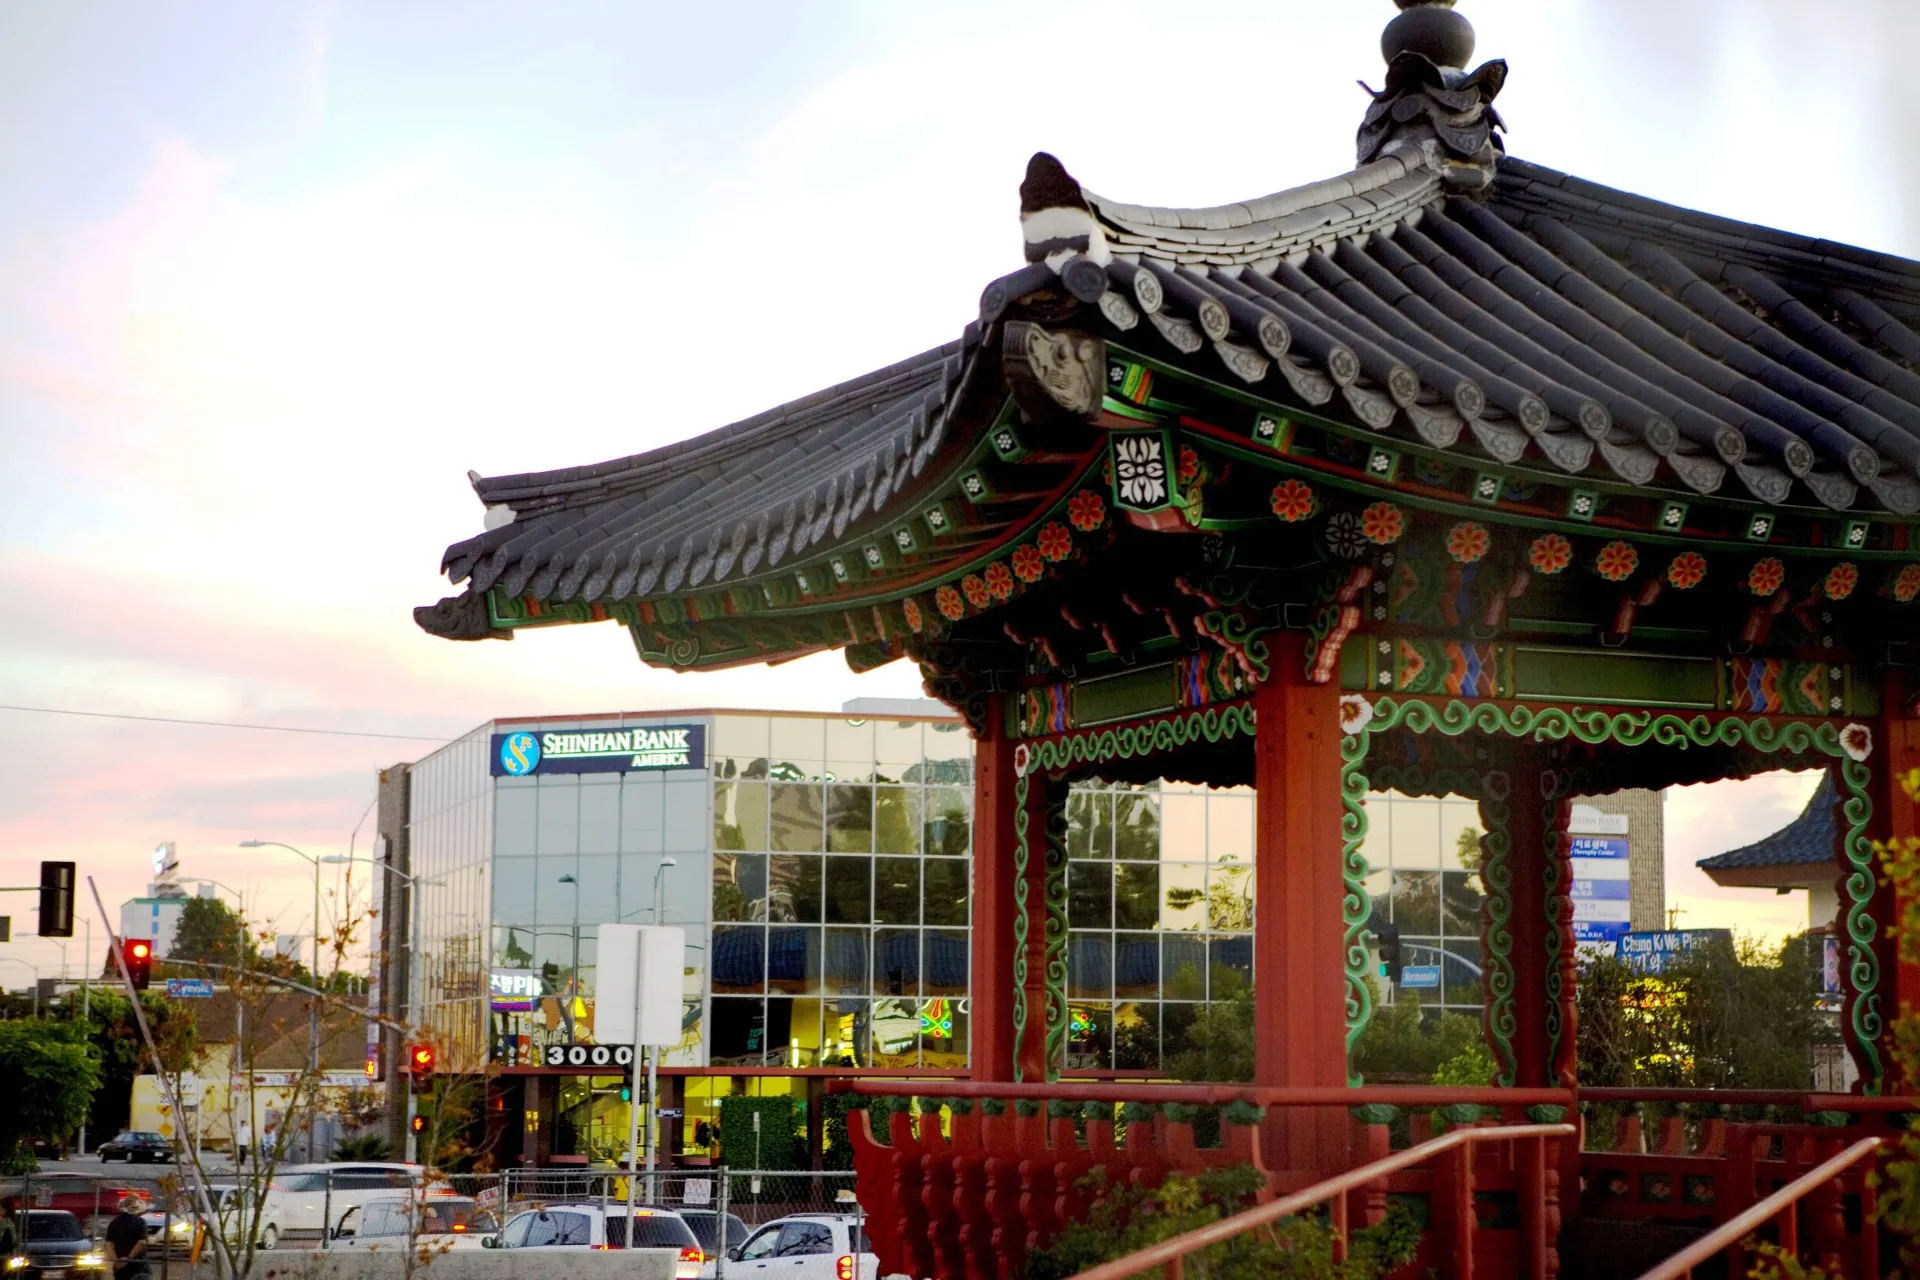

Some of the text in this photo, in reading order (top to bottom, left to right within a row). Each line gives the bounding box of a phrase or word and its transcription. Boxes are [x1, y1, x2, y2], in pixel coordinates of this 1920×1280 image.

[542, 729, 690, 755] SHINHAN BANK
[632, 753, 689, 767] AMERICA
[1622, 935, 1653, 955] Chung
[1664, 934, 1680, 951] Wa
[1404, 971, 1437, 981] Normandie
[547, 1046, 634, 1065] 3000
